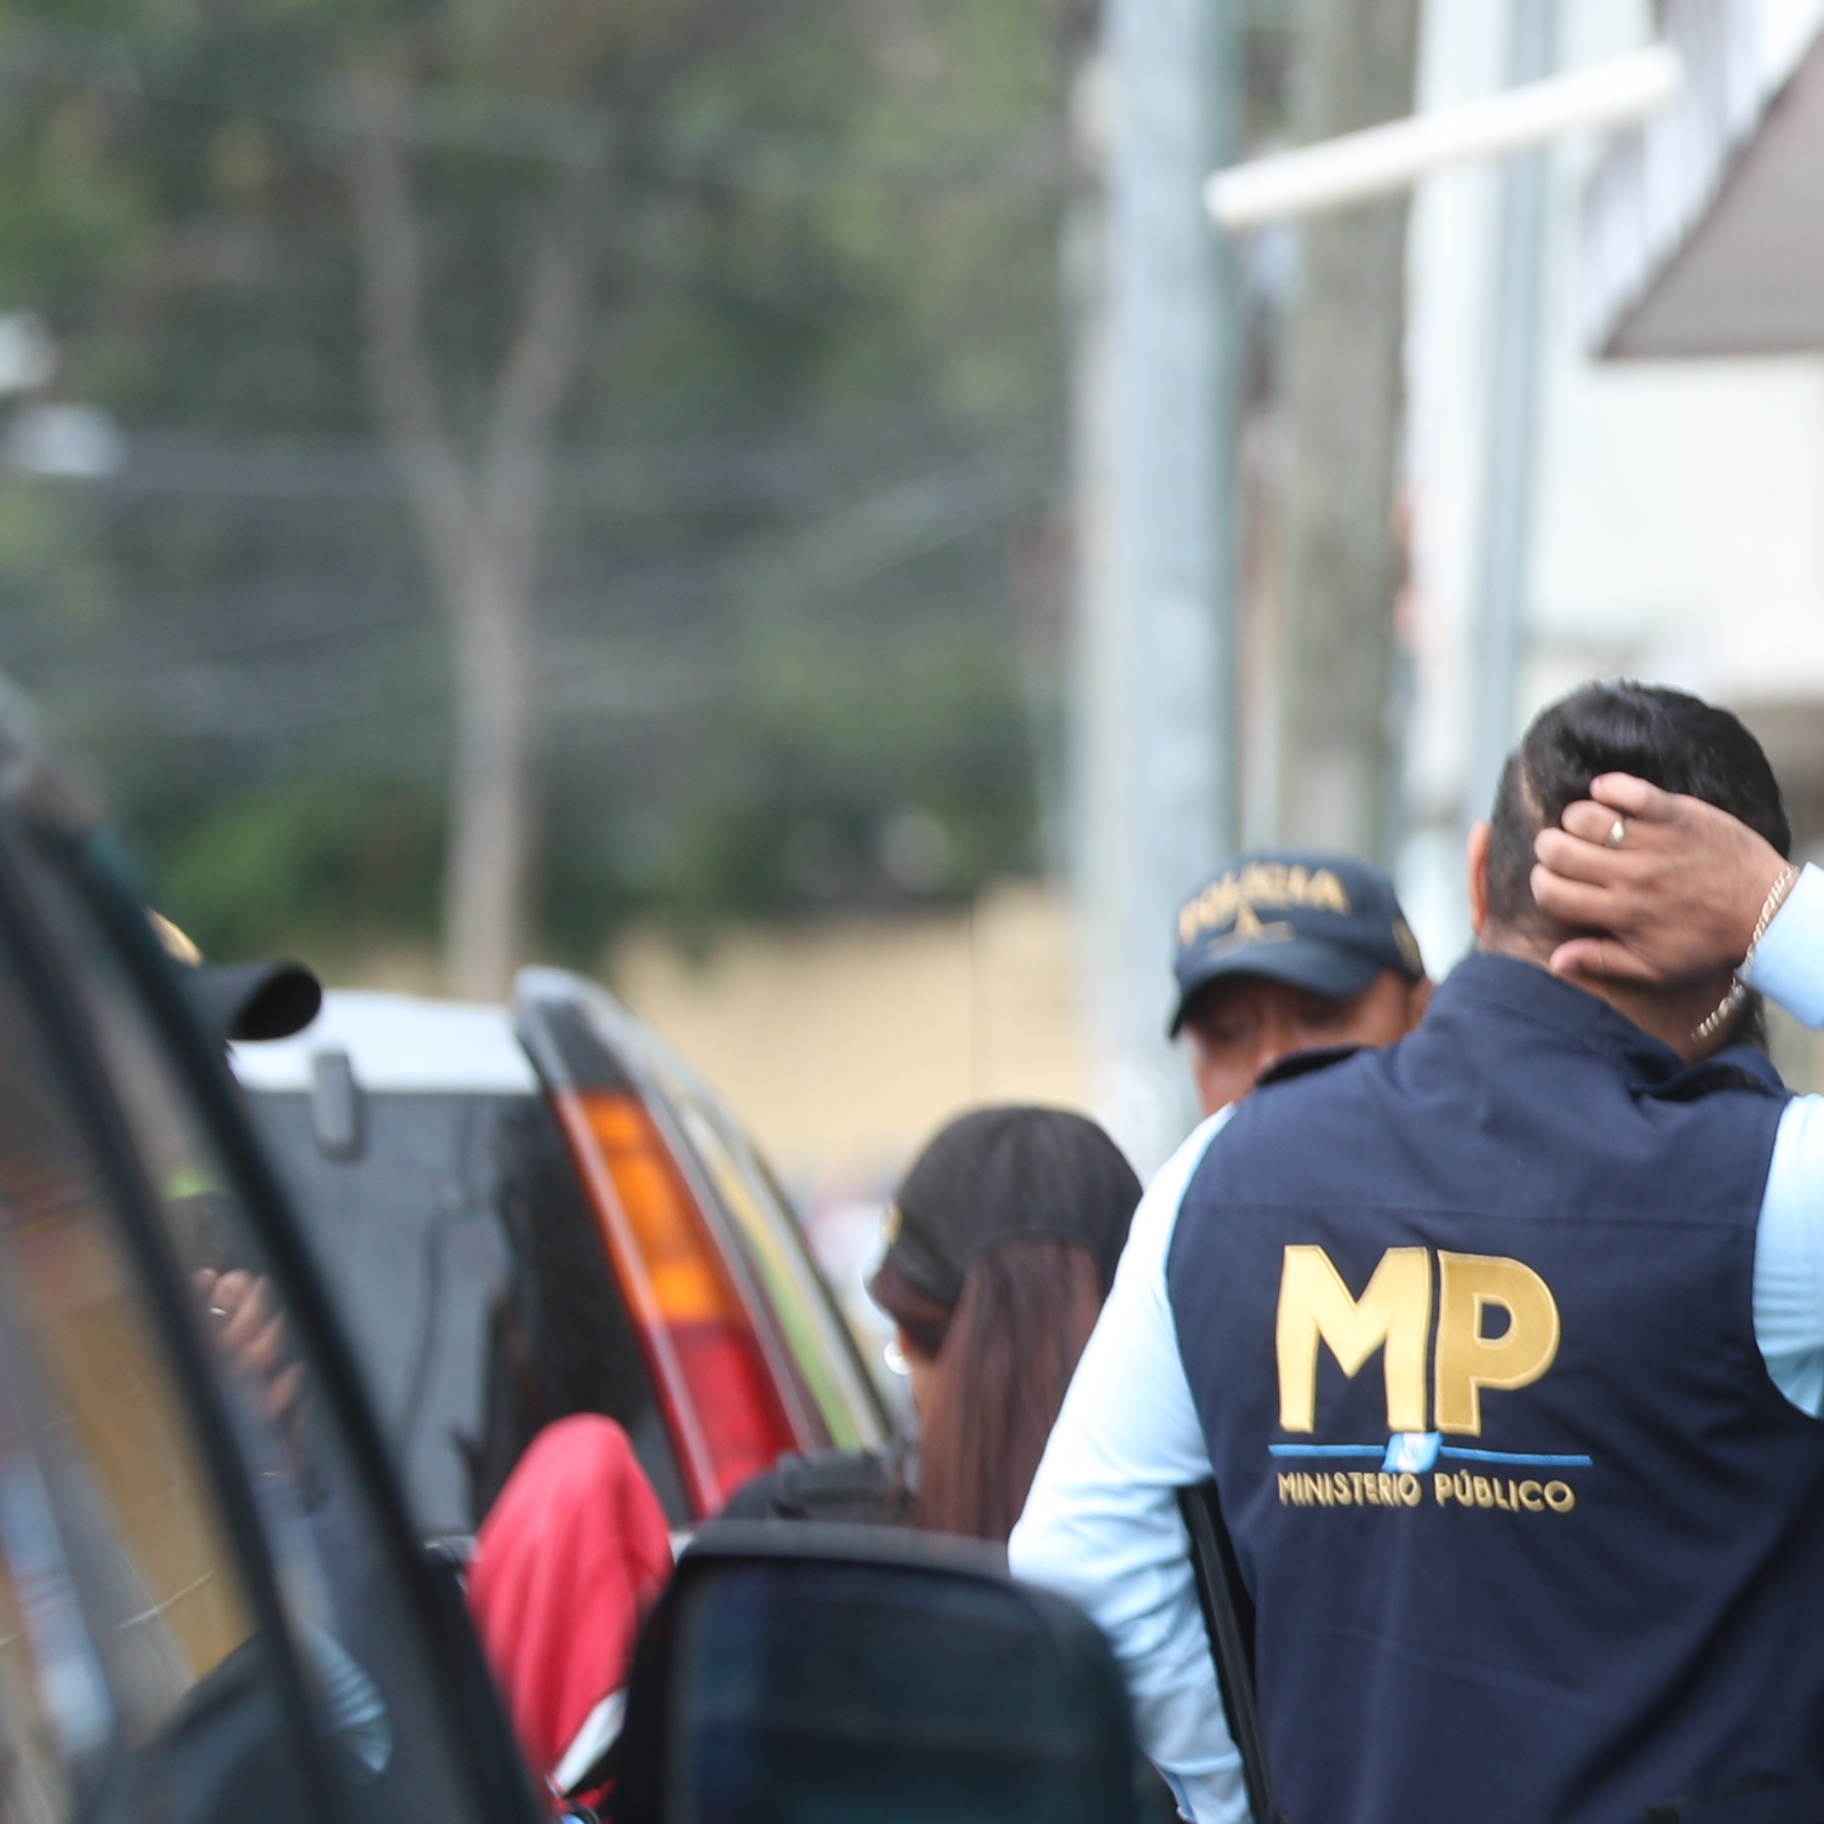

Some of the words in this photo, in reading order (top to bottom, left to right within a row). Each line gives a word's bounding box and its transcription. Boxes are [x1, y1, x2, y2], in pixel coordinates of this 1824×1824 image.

[1275, 1245, 1560, 1437] MP
[1277, 1471, 1423, 1507] MINISTERIO
[1434, 1469, 1576, 1513] PÚBLICO
